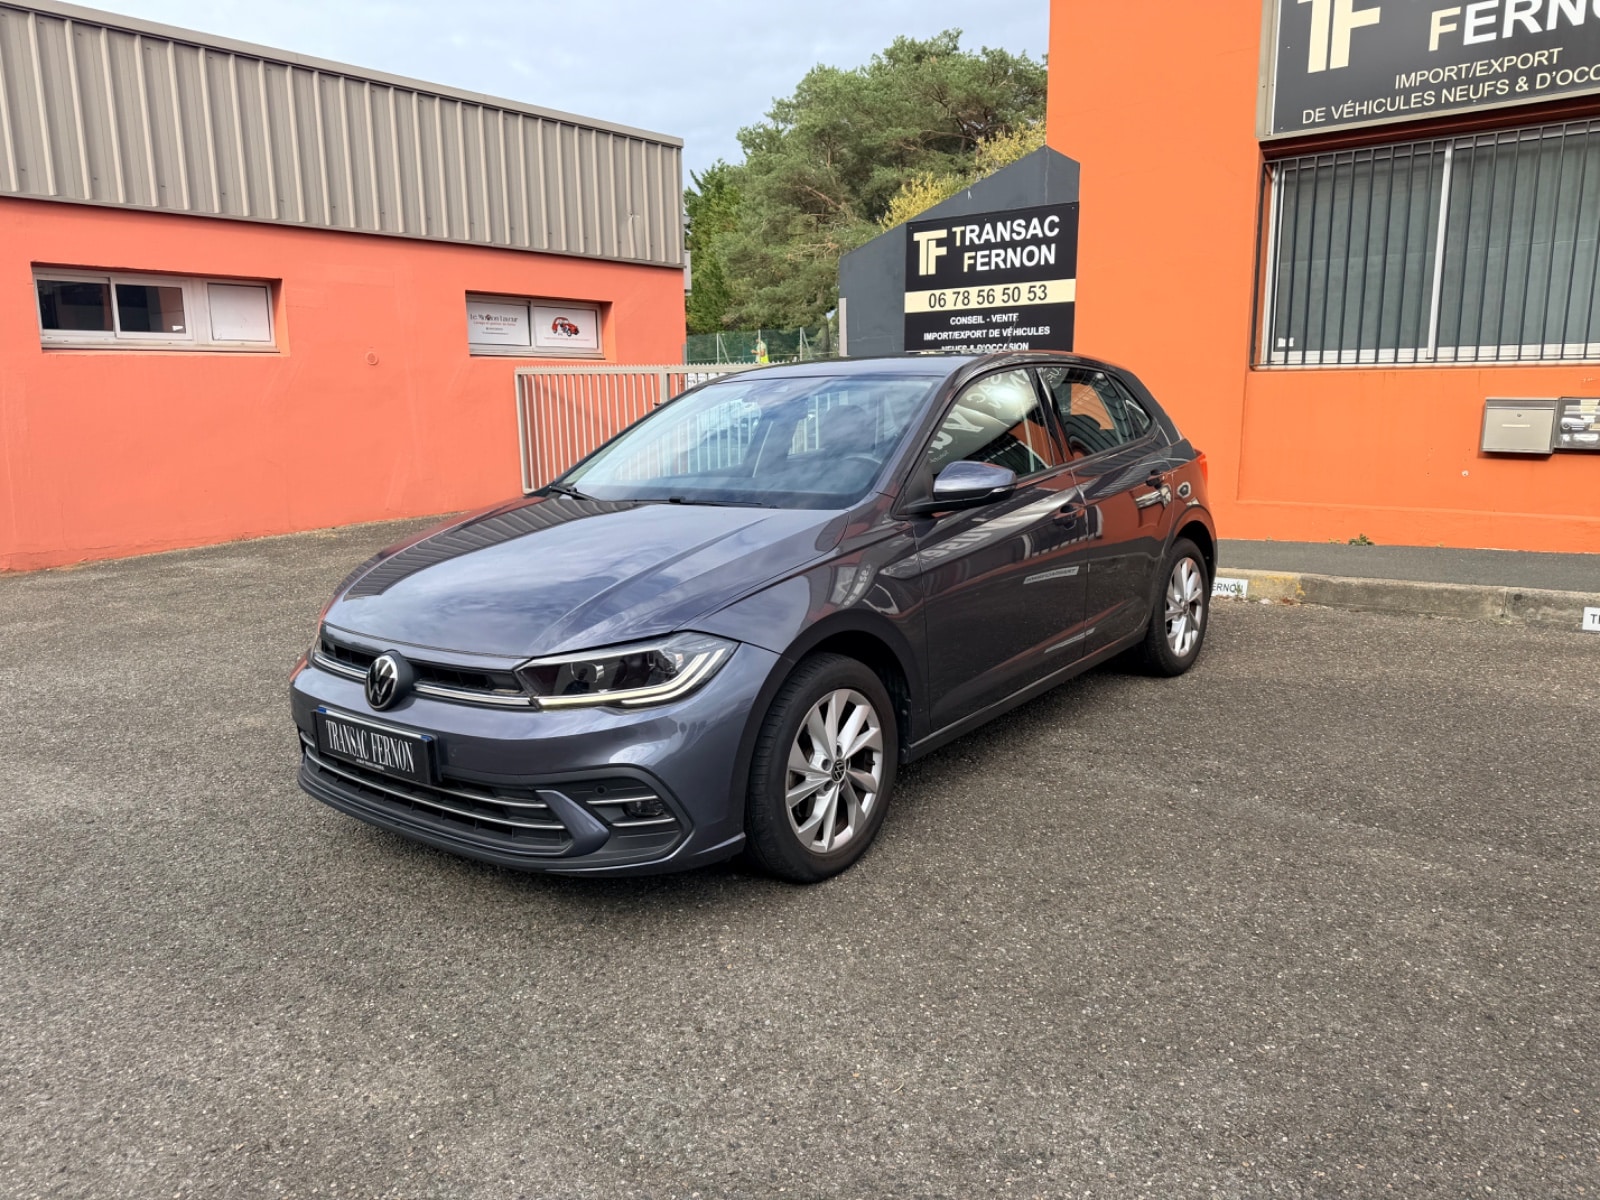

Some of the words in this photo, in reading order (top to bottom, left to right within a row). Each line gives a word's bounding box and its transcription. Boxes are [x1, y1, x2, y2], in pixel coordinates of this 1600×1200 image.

[1394, 47, 1563, 90] IMPORT/EXPORT
[1302, 107, 1326, 124] DE
[1331, 90, 1436, 119] VÉHICULES
[1441, 78, 1509, 104] NEUFS
[1515, 75, 1529, 92] &
[952, 215, 1060, 247] TRANSAC
[913, 229, 948, 276] TF
[963, 243, 1056, 272] FERNON
[928, 292, 947, 309] 06
[952, 290, 970, 307] 78
[976, 288, 995, 305] 56
[1001, 286, 1021, 303] 50
[1027, 284, 1048, 302] 53
[923, 329, 987, 341] IMPORT/EXPORT
[988, 328, 1001, 338] DE
[1002, 326, 1051, 337] VÉHICULES
[949, 315, 985, 325] CONSEIL
[991, 312, 1020, 323] VENTE
[325, 719, 369, 760] TRANSAC
[370, 732, 415, 773] FERNON
